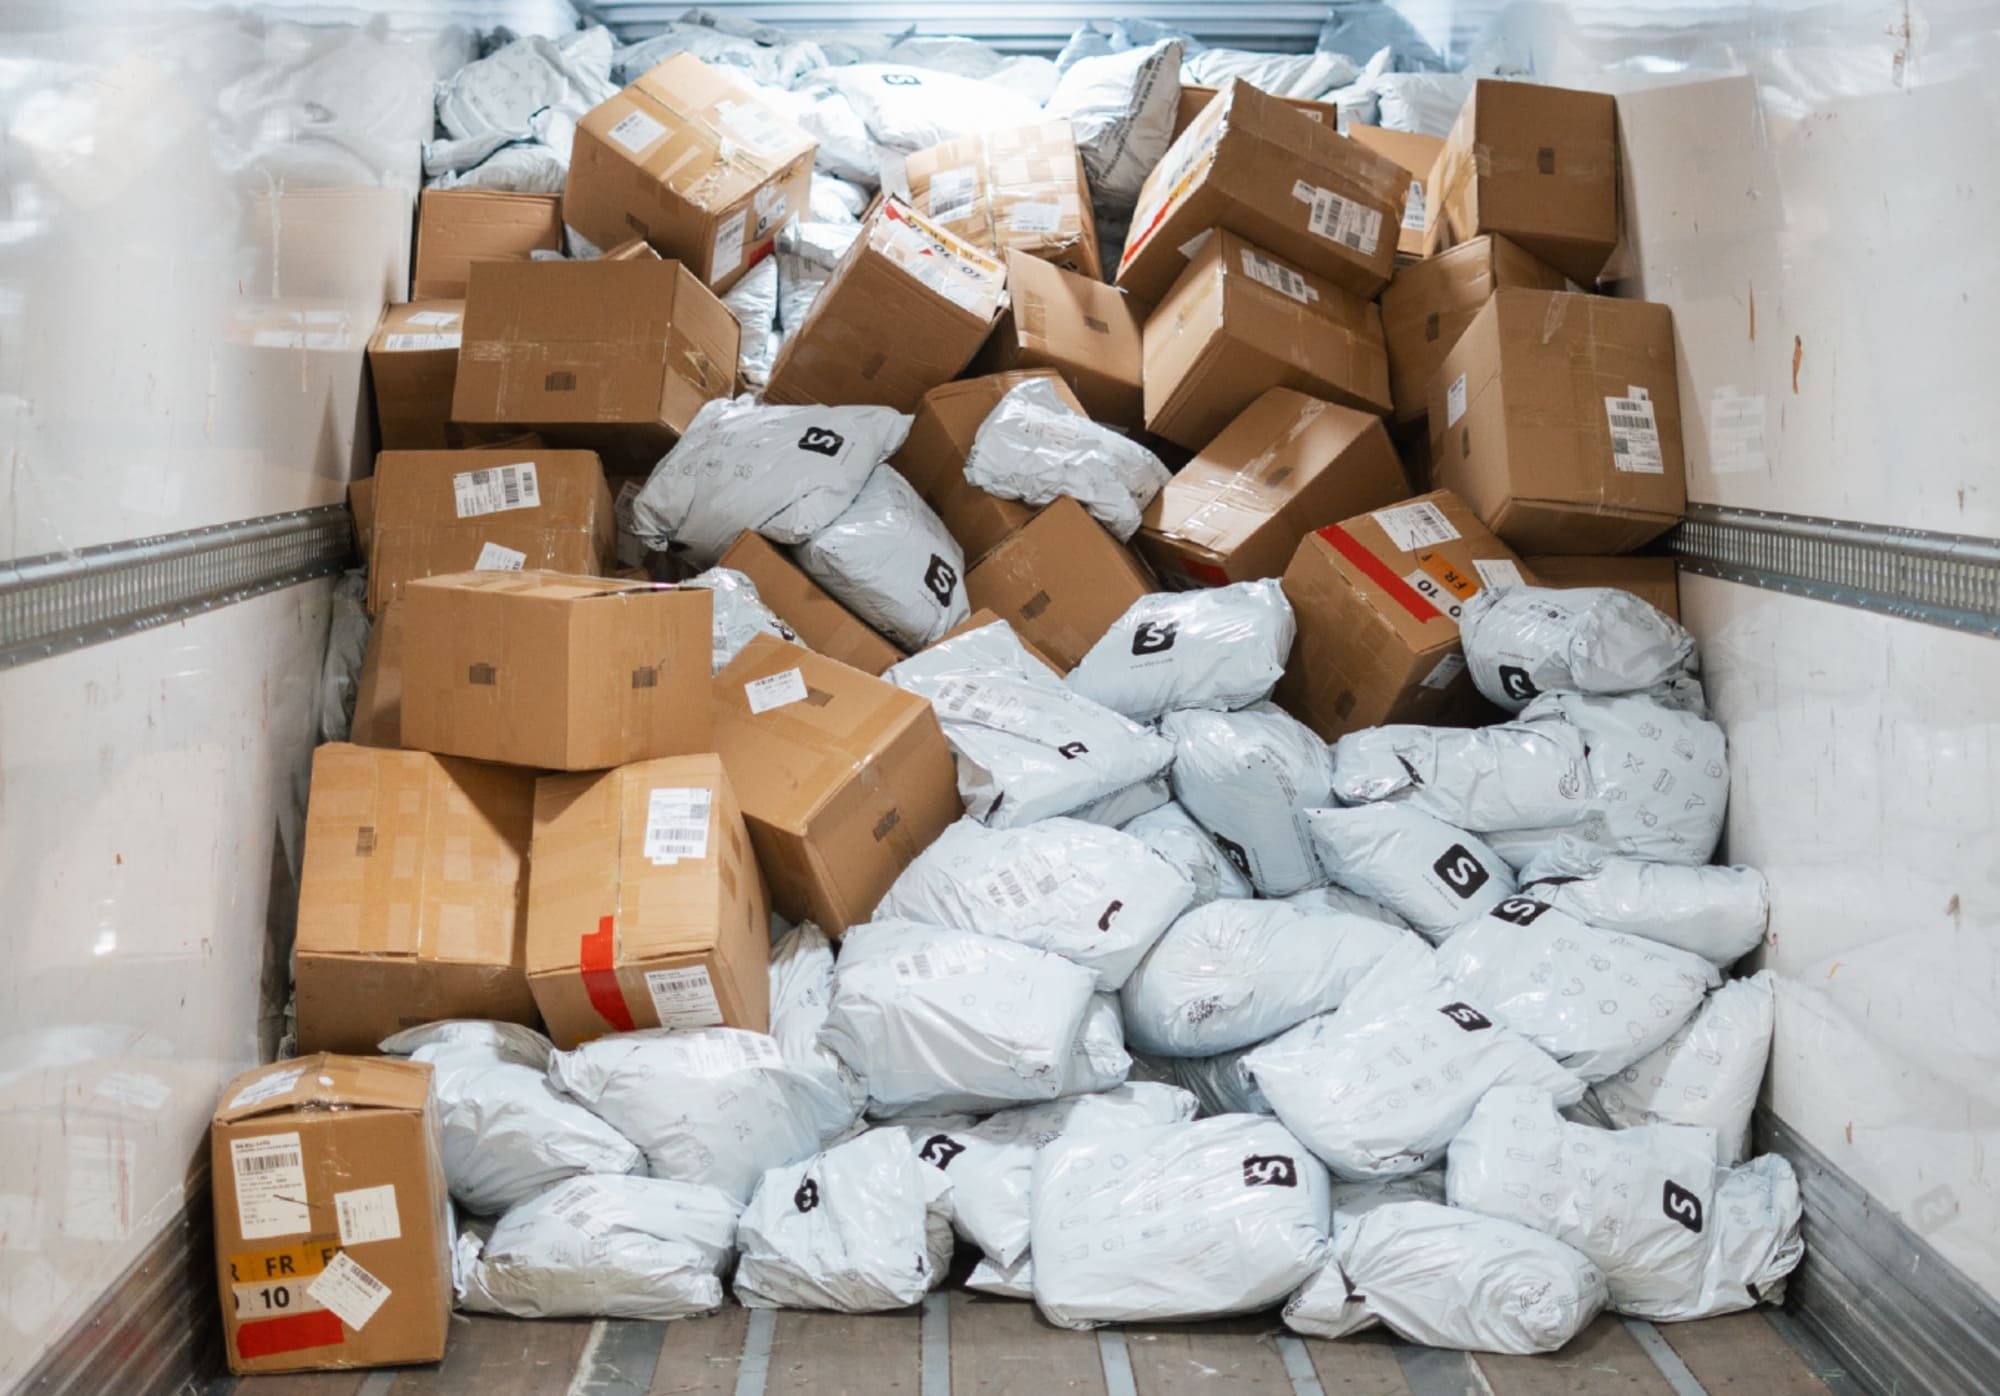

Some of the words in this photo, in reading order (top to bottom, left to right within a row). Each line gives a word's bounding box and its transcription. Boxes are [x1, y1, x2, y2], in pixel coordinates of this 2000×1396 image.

[1417, 580, 1439, 599] 10
[1444, 571, 1468, 591] FR
[265, 1255, 297, 1278] FR
[260, 1286, 290, 1309] 10
